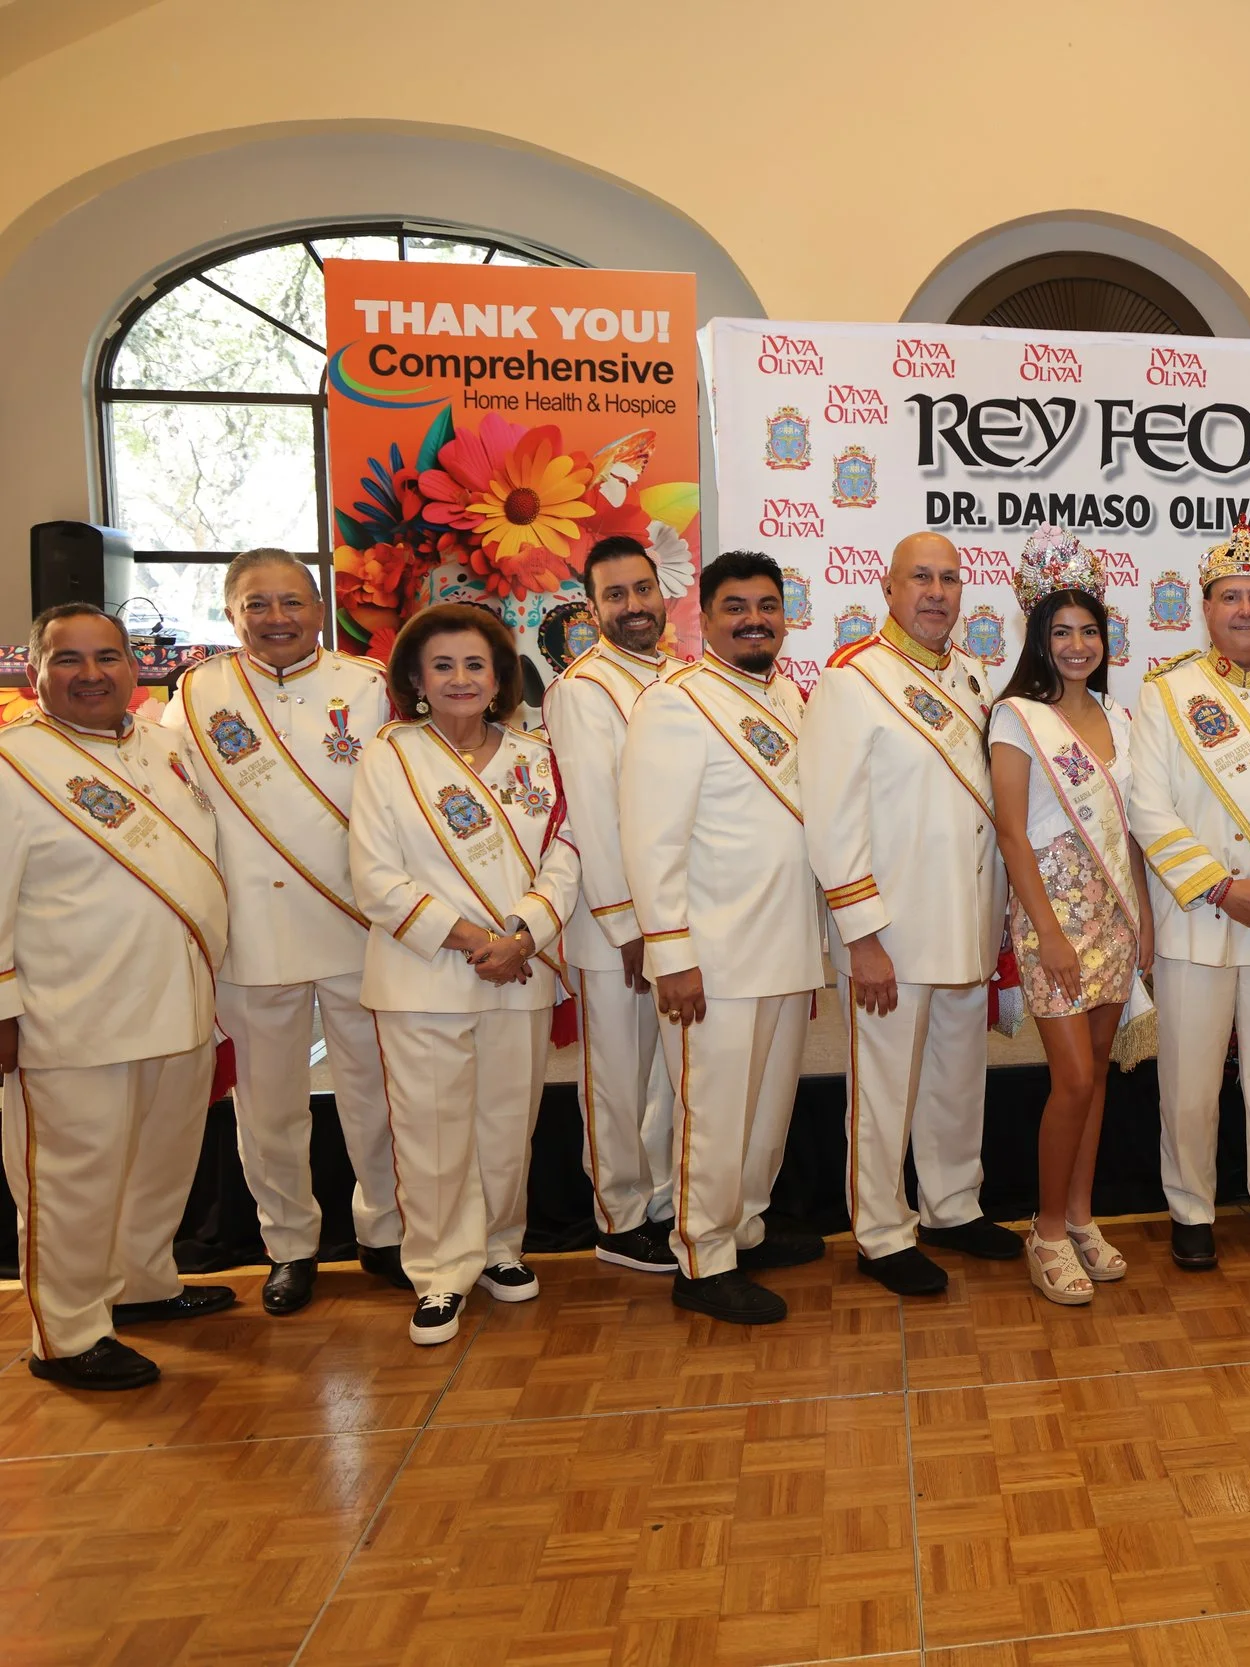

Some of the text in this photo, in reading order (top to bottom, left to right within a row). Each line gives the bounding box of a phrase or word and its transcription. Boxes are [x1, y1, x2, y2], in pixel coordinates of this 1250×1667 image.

[354, 299, 671, 343] THANK YOU!
[368, 344, 675, 386] Comprehensive
[463, 390, 676, 418] Home Health & Hospice
[926, 491, 987, 526] DR.
[998, 492, 1151, 530] DAMASO
